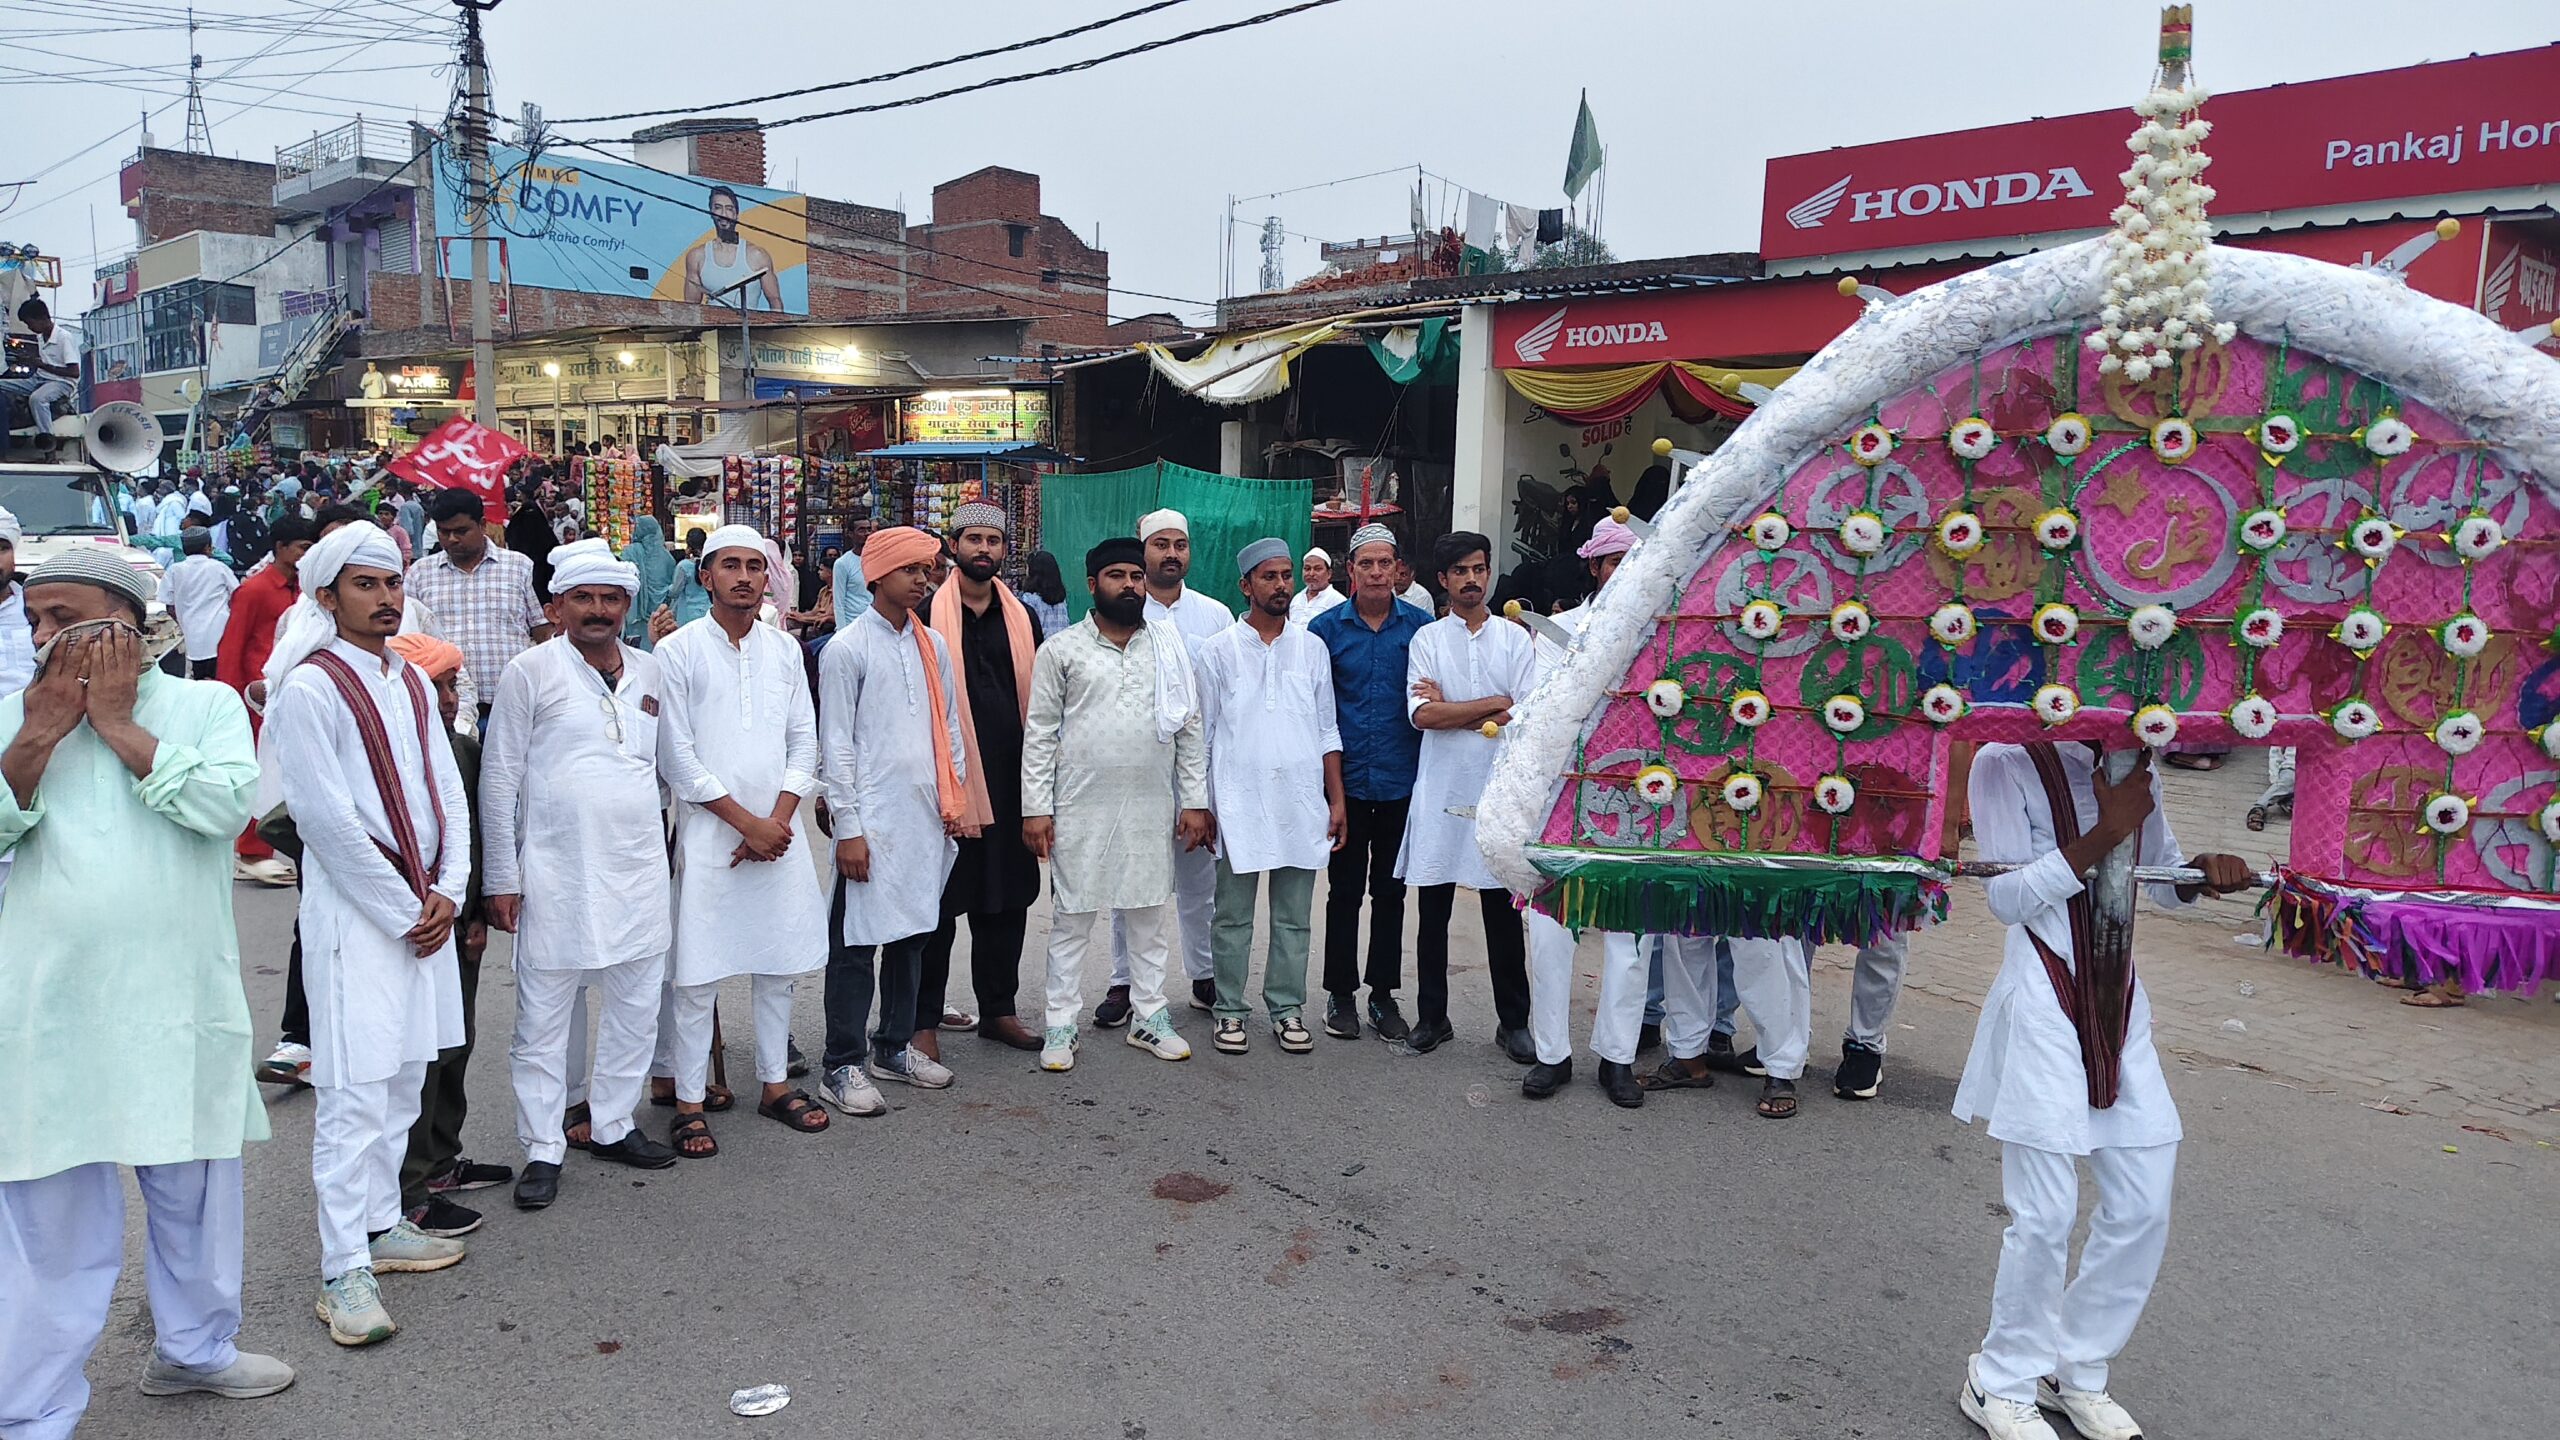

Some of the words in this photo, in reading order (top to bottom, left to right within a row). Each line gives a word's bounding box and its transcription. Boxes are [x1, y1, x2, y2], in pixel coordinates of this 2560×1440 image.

[2325, 125, 2464, 170] Pankaj
[521, 164, 573, 183] MUL
[520, 185, 644, 228] COMFY
[1849, 166, 2095, 223] HONDA
[548, 230, 580, 245] Raho
[583, 235, 625, 252] Comfy!
[1565, 321, 1668, 348] HONDA
[1581, 420, 1622, 448] SOLID
